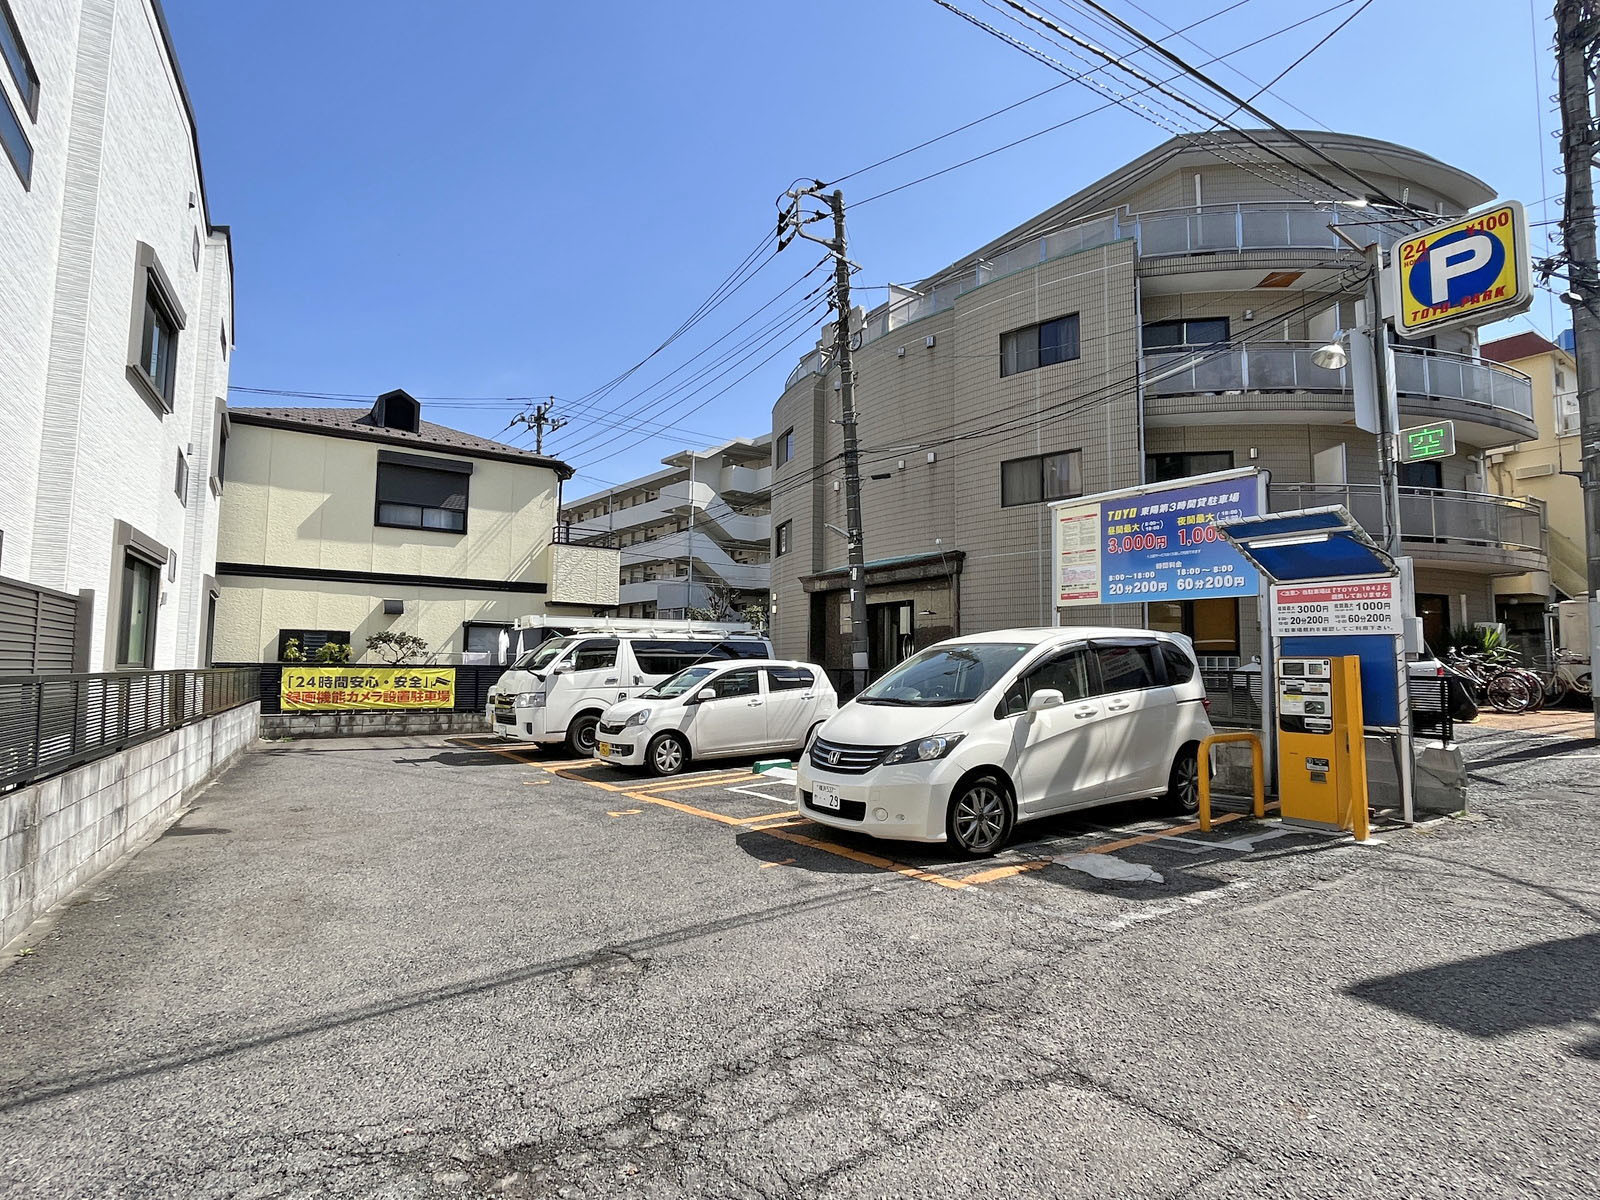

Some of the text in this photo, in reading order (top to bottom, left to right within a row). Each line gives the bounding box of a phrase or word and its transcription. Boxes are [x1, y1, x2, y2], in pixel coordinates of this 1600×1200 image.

[1403, 240, 1428, 260] 24
[1429, 234, 1493, 305] P
[1408, 428, 1445, 459] 空
[1107, 507, 1138, 522] TOYO
[1107, 532, 1168, 554] 3,000円
[1109, 580, 1168, 595] 20分200円
[1176, 575, 1245, 591] 60分200円
[1297, 604, 1329, 613] 3000円
[1355, 601, 1391, 611] 1000円
[1290, 615, 1330, 625] 20分200円
[1348, 613, 1392, 623] 60分200円
[285, 690, 450, 704] 録画機能カメラ設置駐車場
